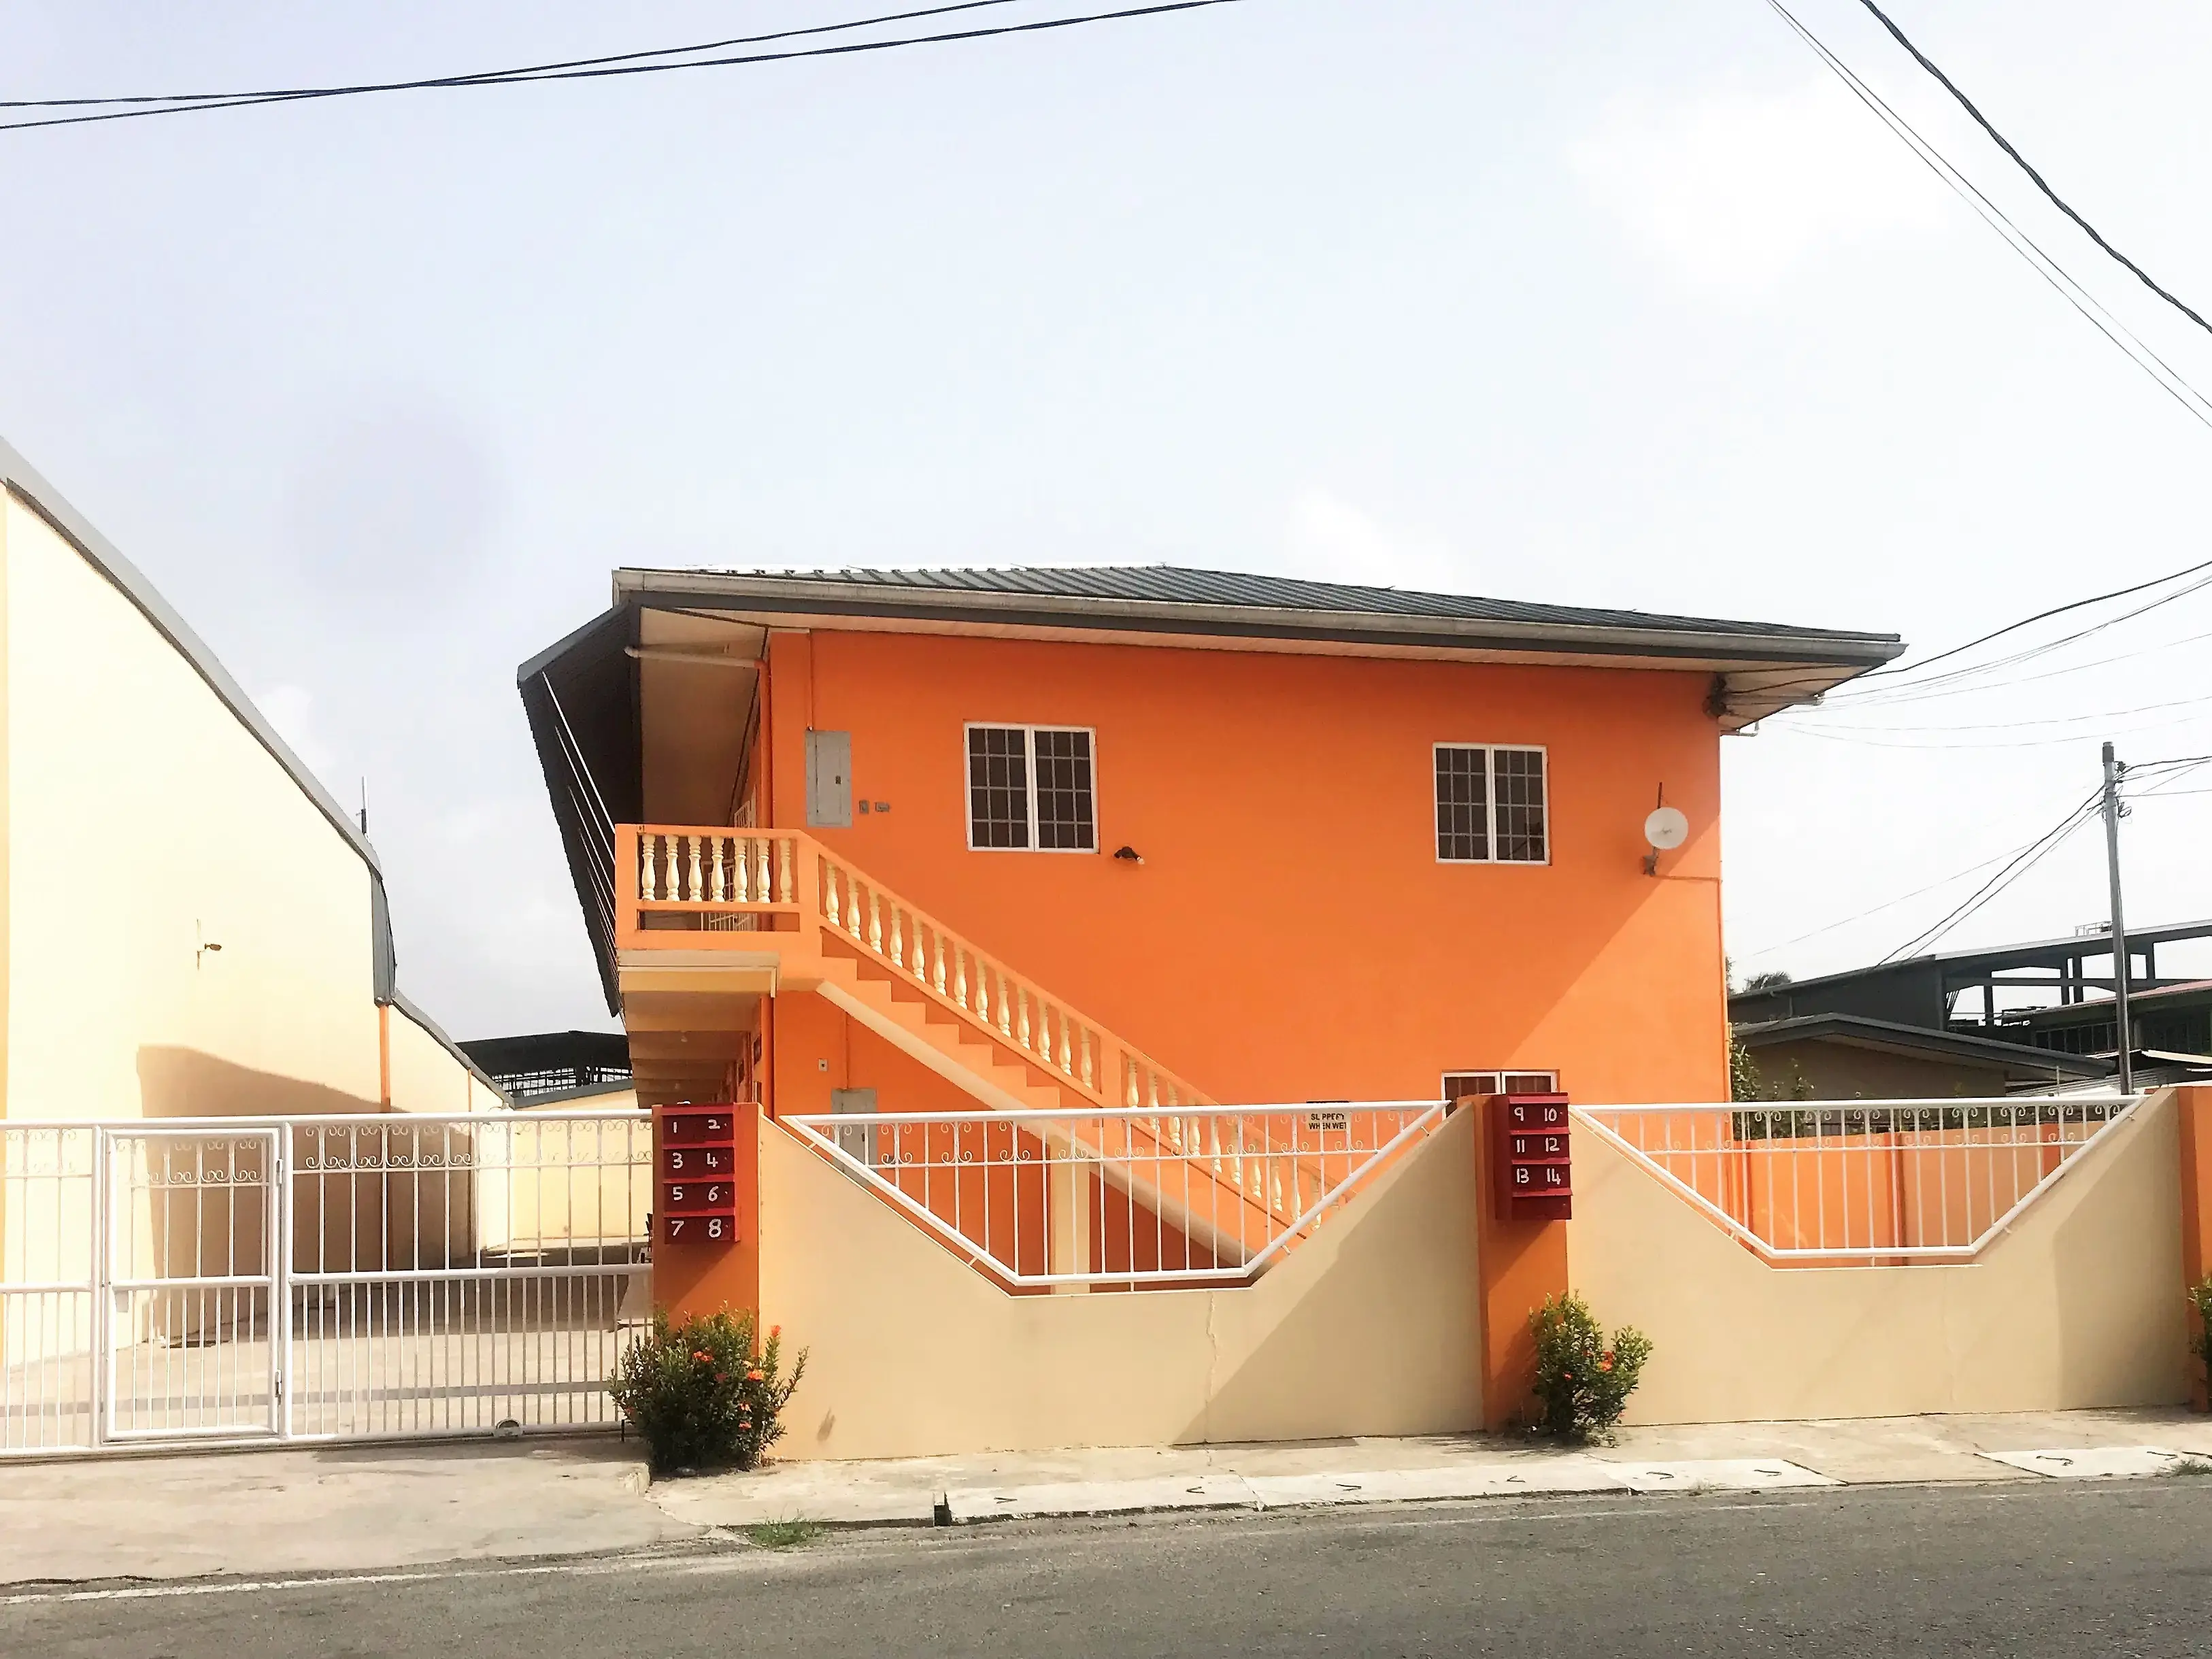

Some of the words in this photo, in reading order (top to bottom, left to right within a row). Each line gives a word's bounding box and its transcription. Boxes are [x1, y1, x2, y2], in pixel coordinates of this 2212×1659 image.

[1514, 1107, 1524, 1121] 9
[1544, 1108, 1557, 1122] 10
[673, 1122, 677, 1133] 1
[708, 1119, 720, 1129] 2
[1516, 1139, 1525, 1153] 11
[1545, 1137, 1560, 1152] 12
[673, 1152, 684, 1169] 3
[707, 1152, 718, 1167] 4
[1516, 1168, 1530, 1184] 13
[1547, 1168, 1561, 1185] 14
[673, 1186, 684, 1201] 5
[708, 1186, 719, 1201] 6
[671, 1220, 684, 1236] 7
[709, 1218, 721, 1237] 8
